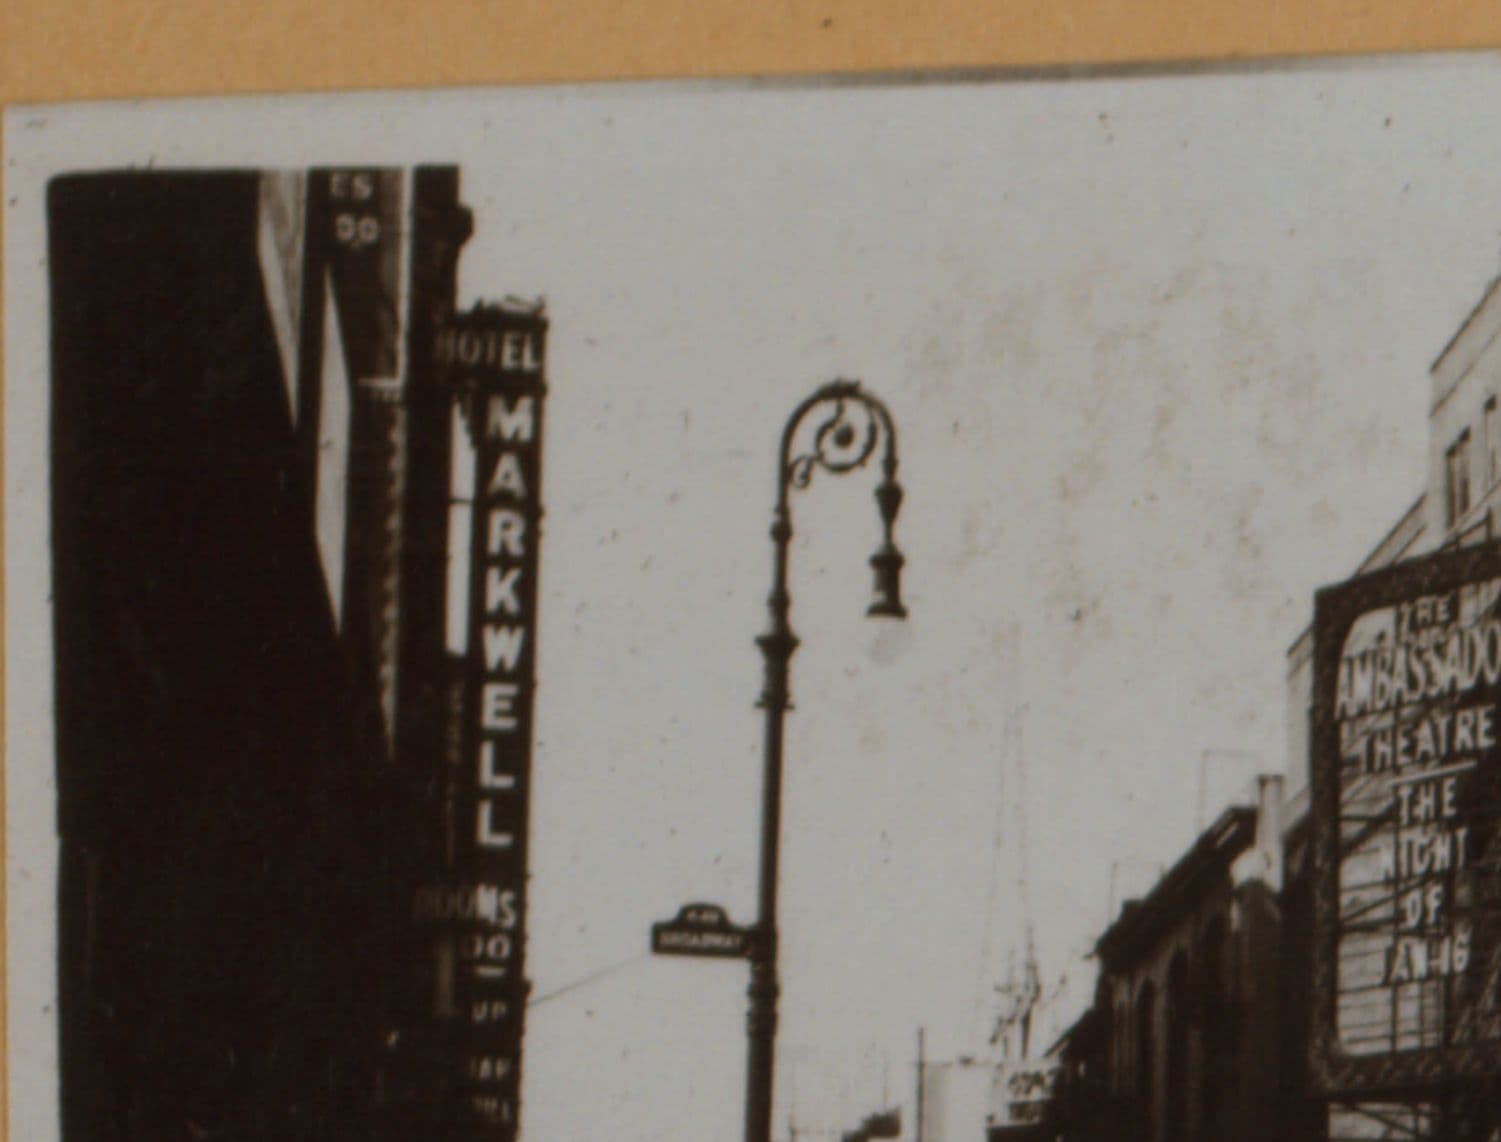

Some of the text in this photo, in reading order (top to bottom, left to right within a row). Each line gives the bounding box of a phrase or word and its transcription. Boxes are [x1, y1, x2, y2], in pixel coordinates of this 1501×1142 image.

[477, 394, 534, 847] MARKWELL
[1358, 703, 1496, 772] THEATRE
[1397, 777, 1457, 825] THE
[1401, 883, 1444, 929] OF
